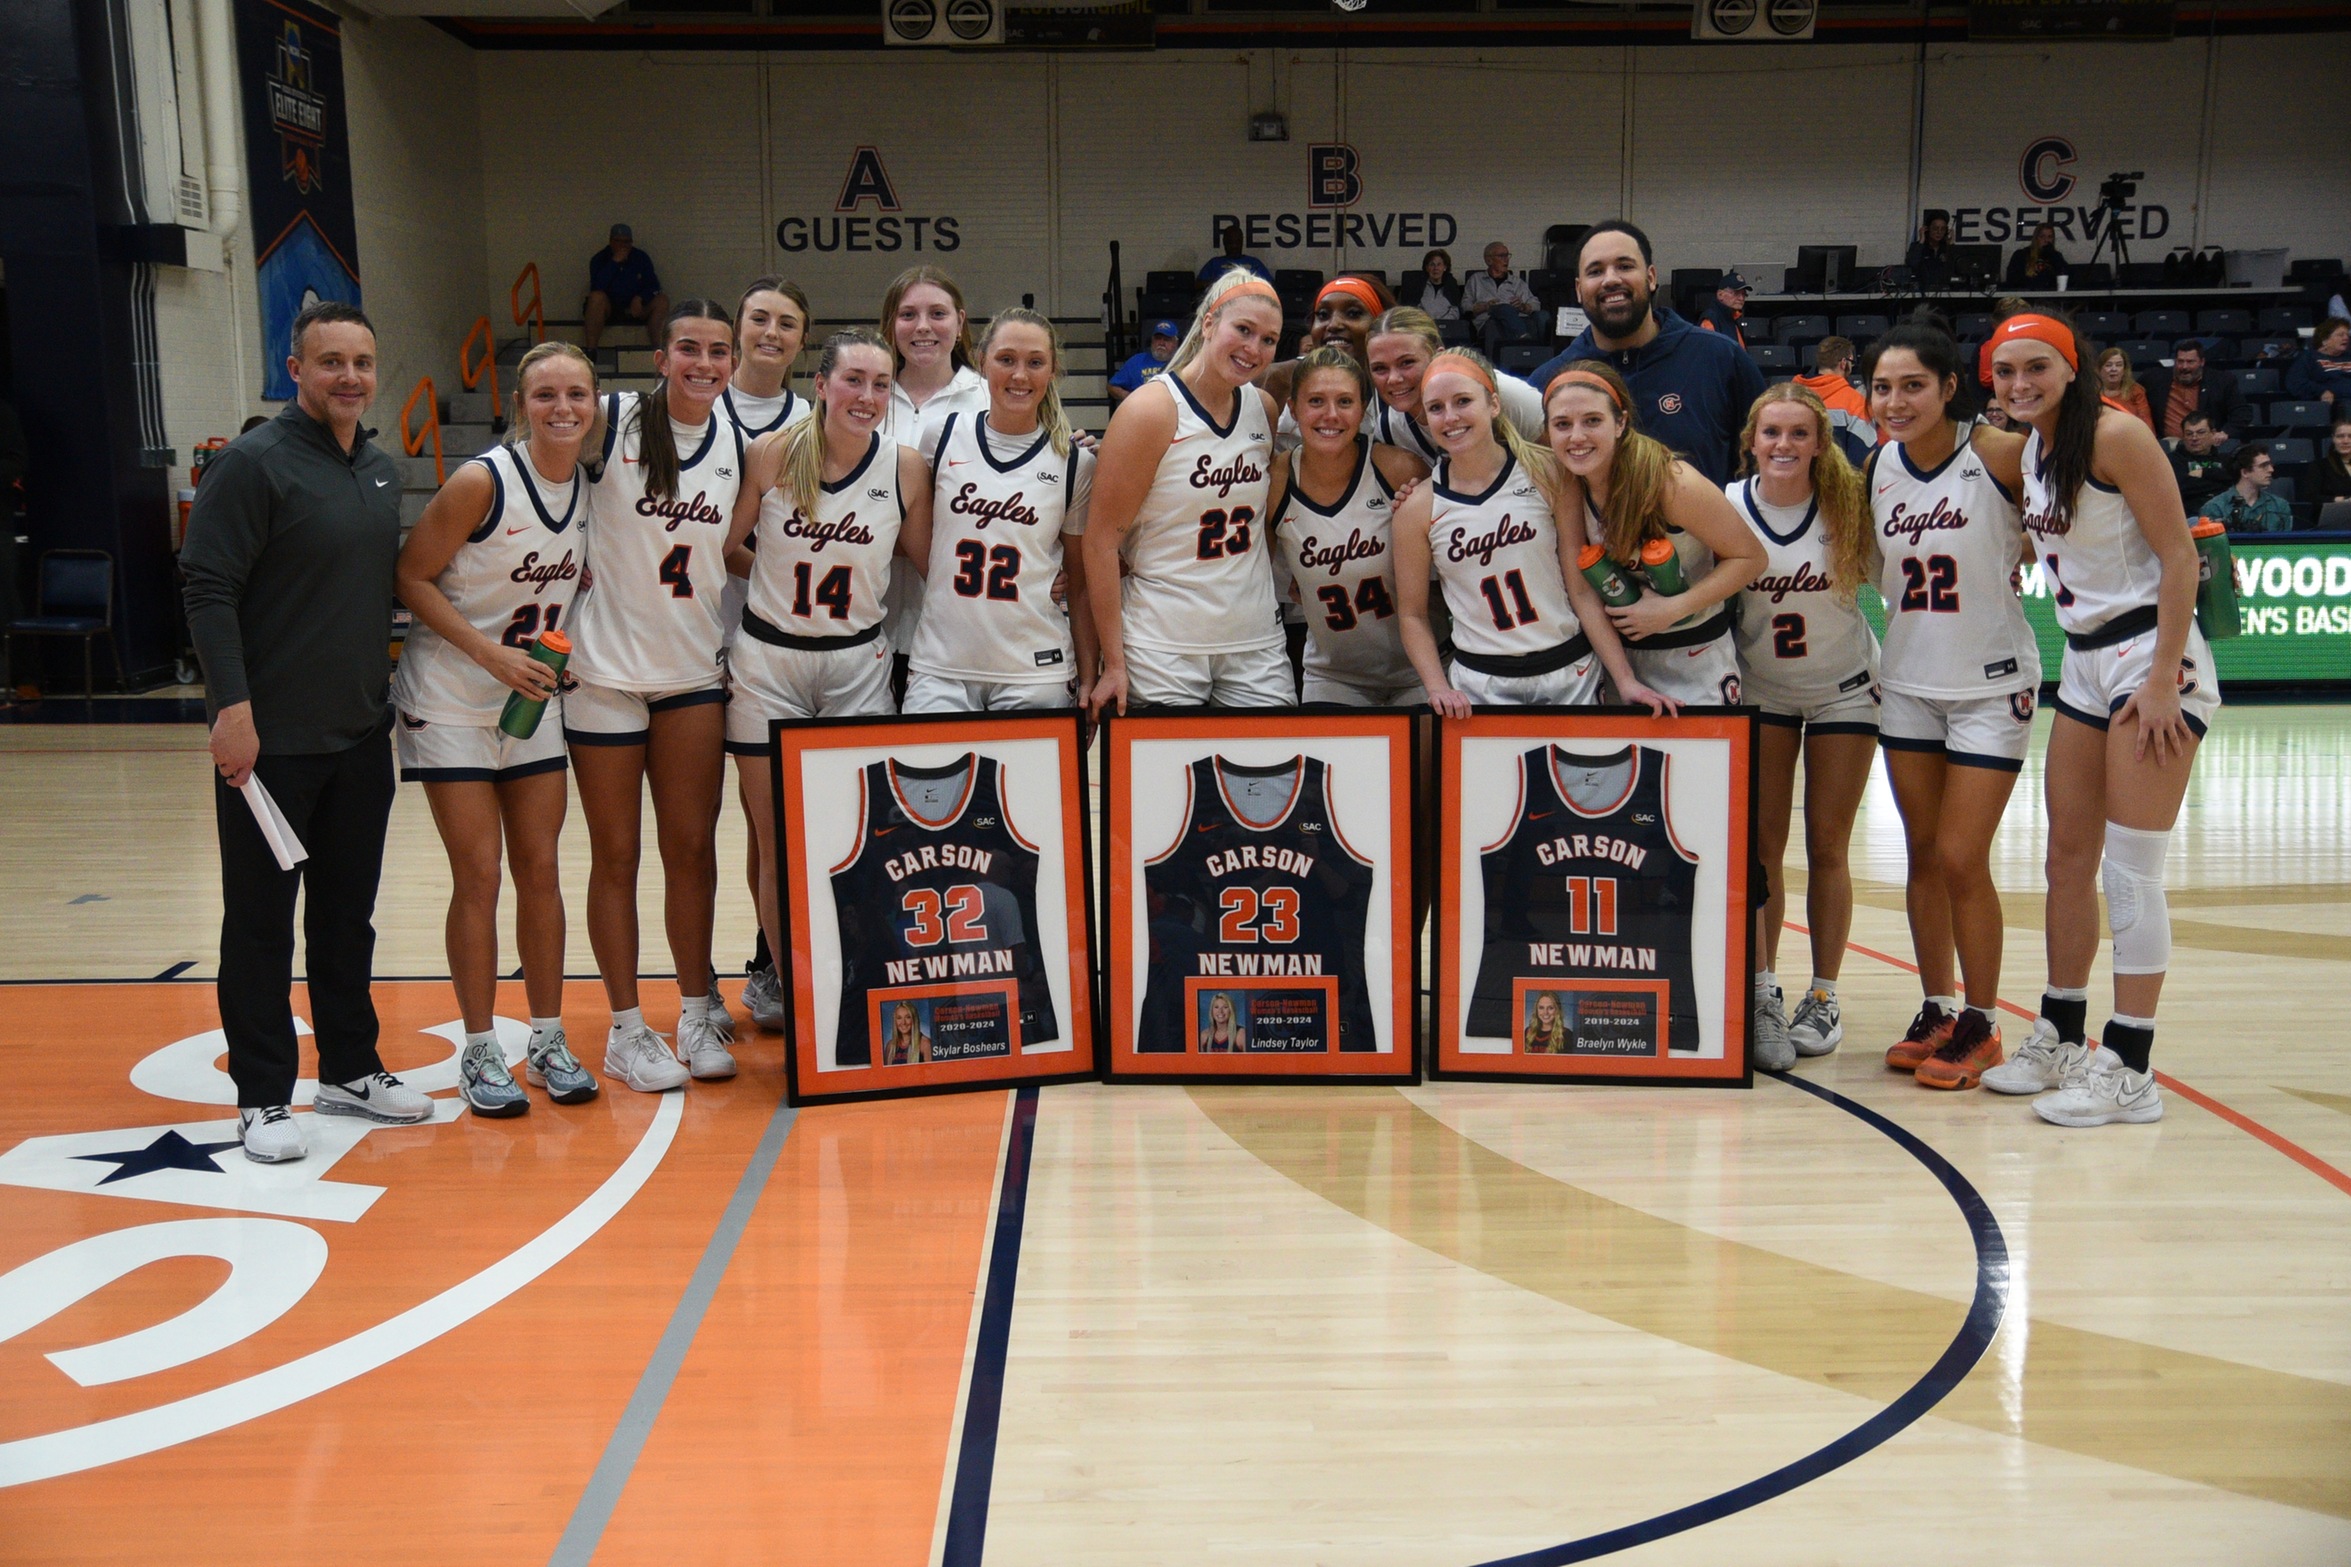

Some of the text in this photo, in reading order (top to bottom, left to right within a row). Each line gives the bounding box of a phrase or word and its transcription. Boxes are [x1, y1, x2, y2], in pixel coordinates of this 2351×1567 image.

[835, 145, 902, 212] A
[1308, 143, 1363, 209] B
[2019, 136, 2079, 204] C
[776, 216, 960, 252] GUESTS
[1213, 213, 1457, 248] RESERVED
[870, 488, 888, 499] SAC
[1040, 472, 1059, 483] SAC
[1189, 453, 1262, 499] Eagles
[1962, 468, 1981, 478] SAC
[636, 489, 722, 532] Eagles
[950, 482, 1039, 529] Eagles
[1884, 497, 1968, 546] Eagles
[784, 506, 874, 553] Eagles
[1197, 505, 1255, 560] 23
[1447, 513, 1537, 566] Eagles
[510, 548, 577, 594] Eagle
[659, 544, 693, 599] 4
[953, 538, 1022, 602] 32
[1299, 528, 1385, 576] Eagles
[791, 561, 852, 620] 14
[1316, 575, 1395, 632] 34
[1480, 568, 1539, 631] 11
[1901, 554, 1960, 613] 22
[501, 603, 562, 652] 21
[1772, 613, 1807, 659] 2
[2295, 606, 2351, 635] BAS
[976, 817, 995, 826] SAC
[1302, 823, 1322, 831] SAC
[1635, 813, 1655, 822] SAC
[884, 843, 993, 883] CARSON
[1206, 845, 1314, 879] CARSON
[1536, 834, 1647, 871] CARSON
[902, 884, 988, 948] 32
[1219, 886, 1300, 943] 23
[1566, 875, 1617, 936] 11
[885, 949, 1014, 985] NEWMAN
[1198, 953, 1322, 976] NEWMAN
[1528, 942, 1656, 971] NEWMAN
[940, 1020, 995, 1032] 2020-2024
[1256, 1016, 1312, 1025] 2020-2024
[1584, 1017, 1640, 1026] 2019-2024
[932, 1042, 1006, 1058] Skylar Boshears
[1251, 1036, 1319, 1050] Lindsey Taylor
[1576, 1037, 1647, 1051] Braelyn Wykle
